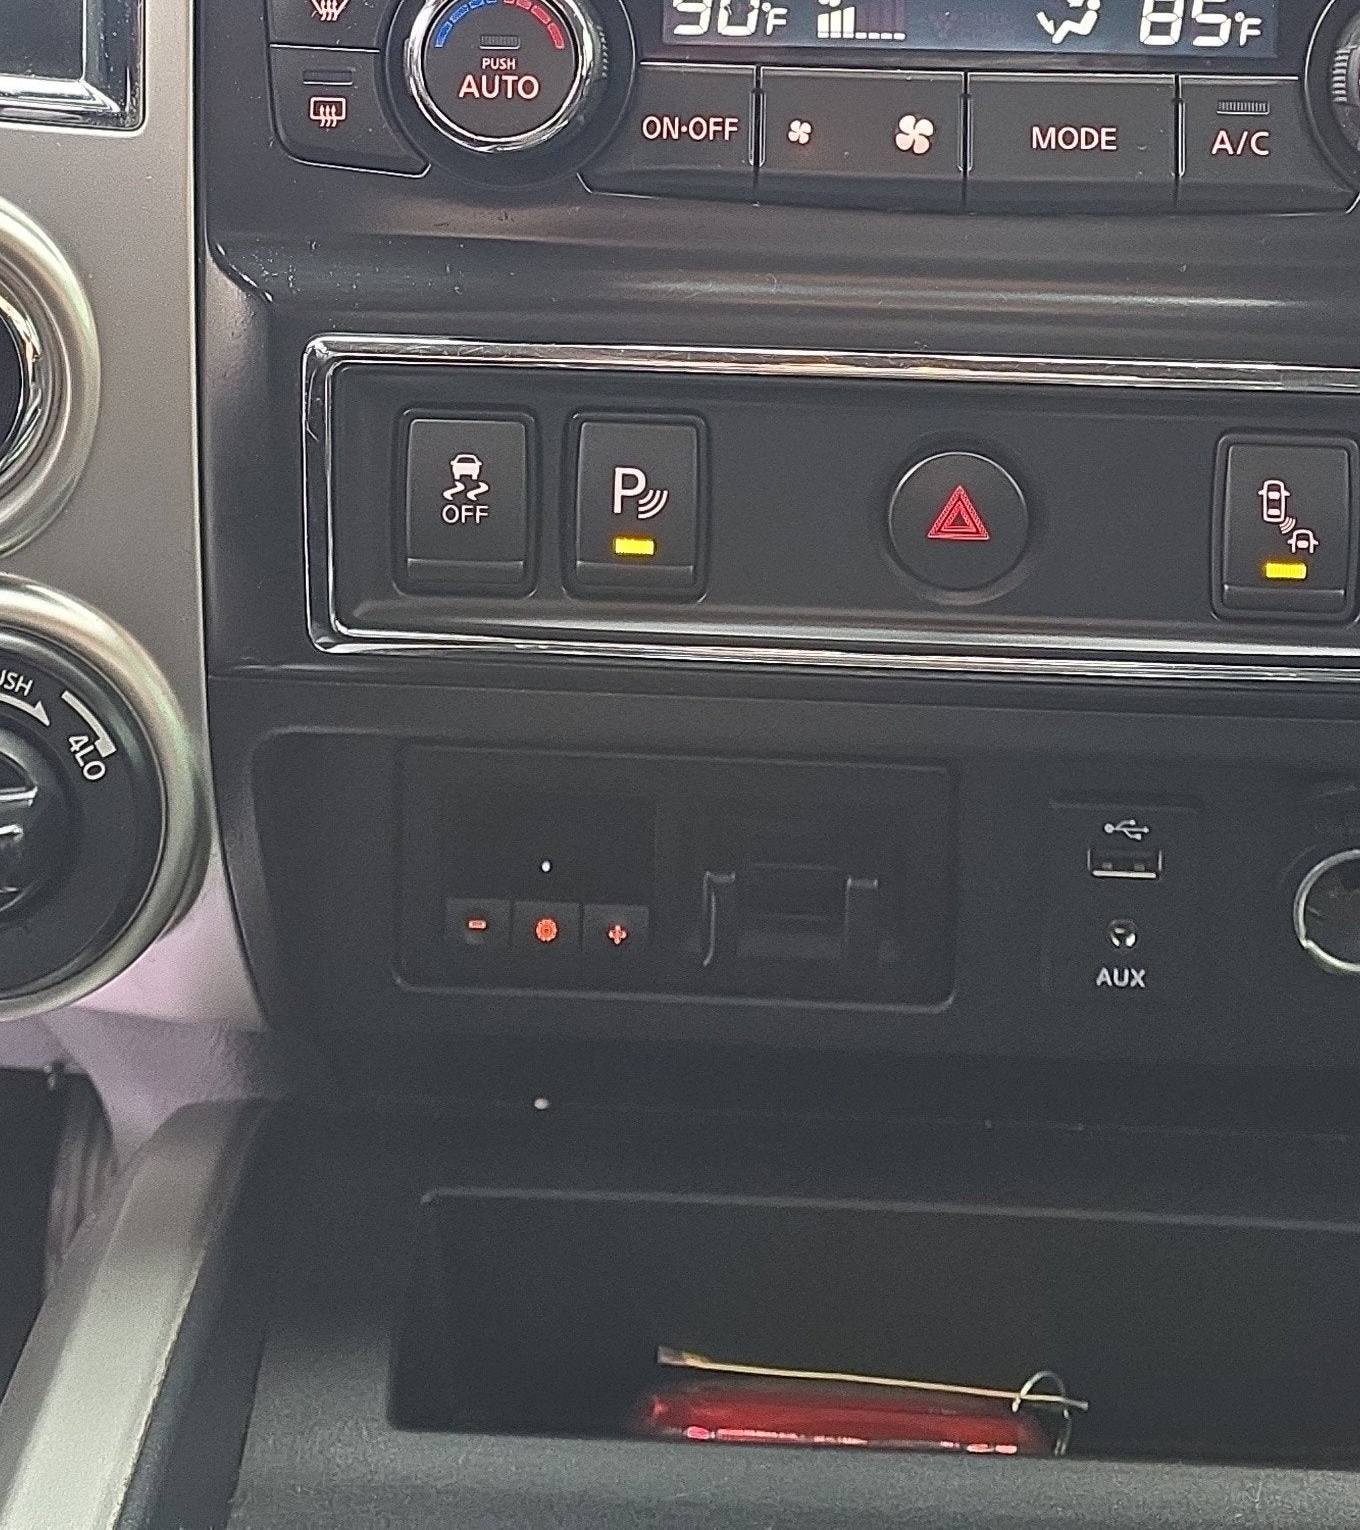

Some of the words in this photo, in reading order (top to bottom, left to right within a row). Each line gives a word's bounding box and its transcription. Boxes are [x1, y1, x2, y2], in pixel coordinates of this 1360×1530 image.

[481, 57, 516, 70] PUSH
[458, 74, 539, 100] AUTO
[1031, 126, 1117, 151] MODE
[1211, 130, 1270, 156] A/C
[613, 467, 646, 514] P
[442, 504, 489, 524] OFF
[67, 733, 106, 782] 4LO
[1096, 968, 1146, 988] AUX
